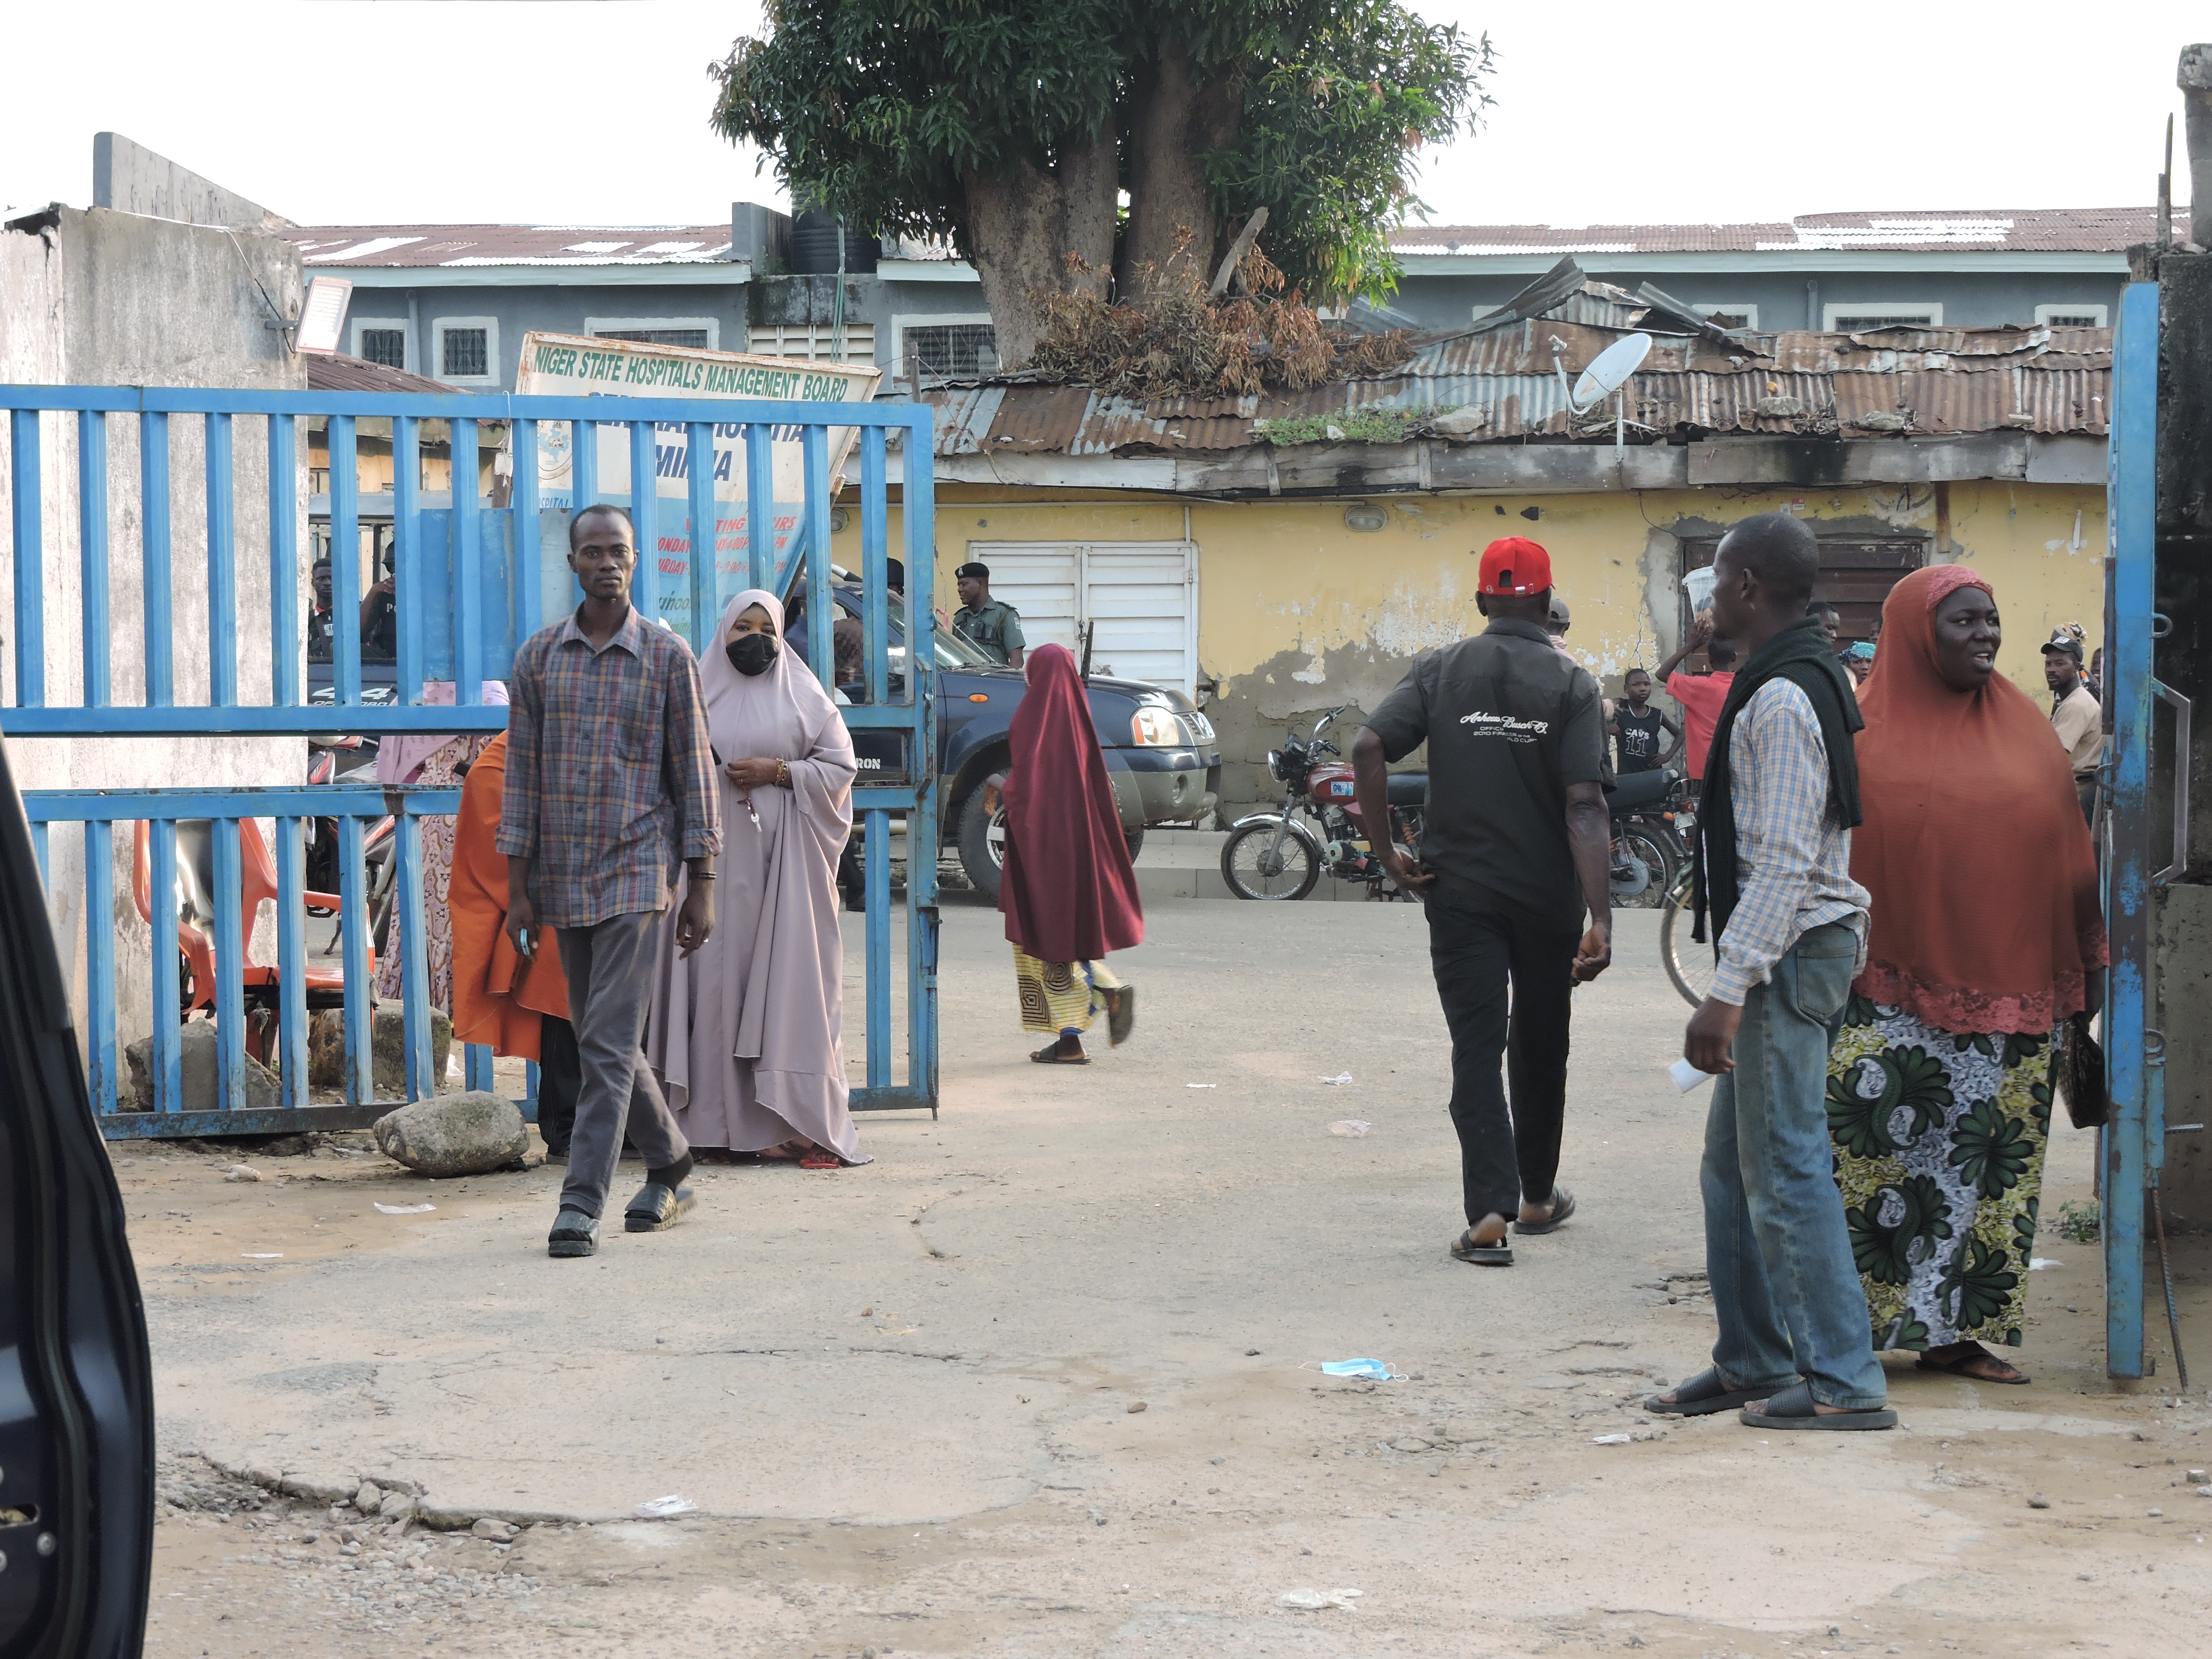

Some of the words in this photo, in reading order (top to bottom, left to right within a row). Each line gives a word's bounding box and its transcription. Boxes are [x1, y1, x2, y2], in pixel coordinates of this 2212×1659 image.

[533, 346, 577, 377] NIGER
[578, 352, 625, 382] STATE
[625, 357, 703, 390] HOSPITALS
[704, 365, 801, 399] MANAGEMENT
[802, 374, 849, 402] BOARD
[656, 445, 733, 481] MIA
[1624, 728, 1650, 740] CAVS
[1625, 735, 1646, 757] 11
